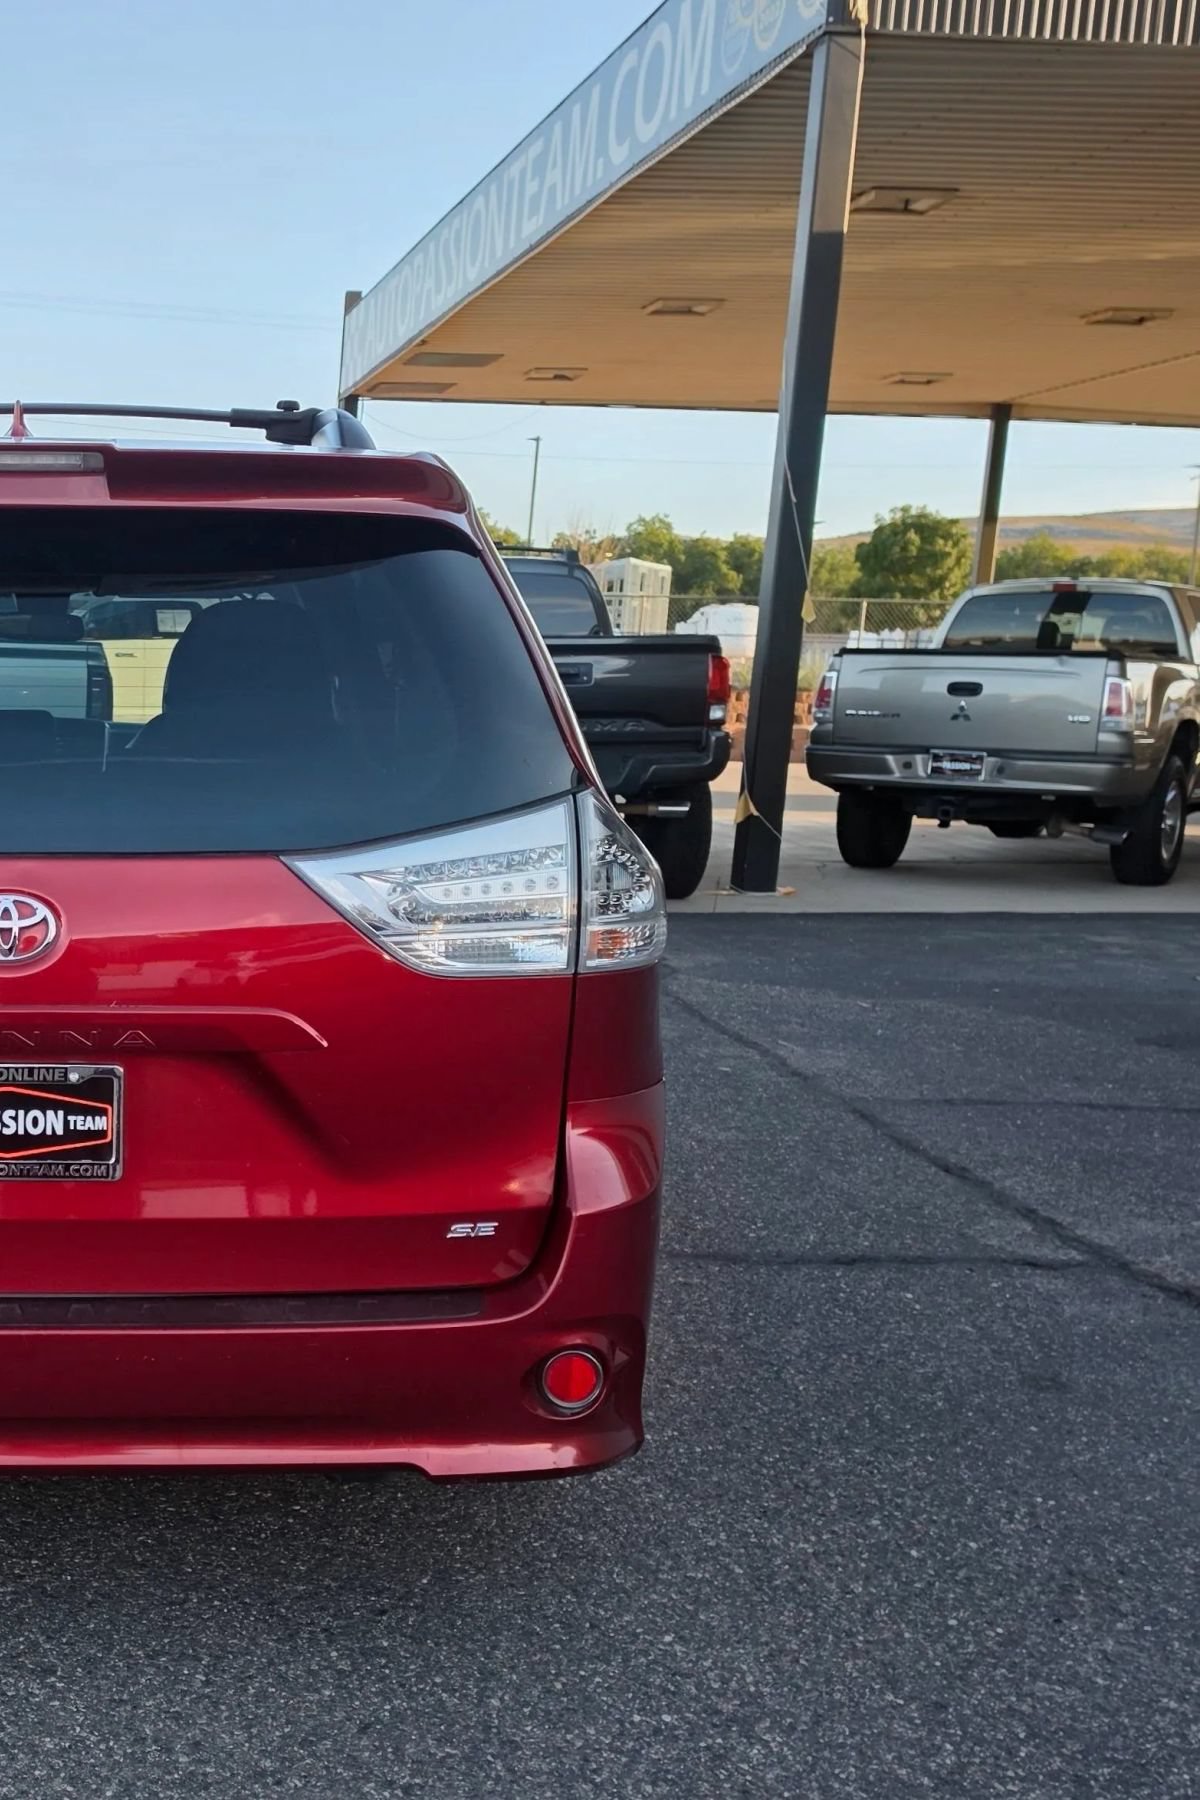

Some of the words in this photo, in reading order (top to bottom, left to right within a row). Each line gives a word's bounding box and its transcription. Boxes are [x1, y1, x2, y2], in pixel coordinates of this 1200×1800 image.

[363, 0, 717, 363] AUTOPASSIONTEAM.COM
[67, 1116, 107, 1130] TEAM
[446, 1222, 499, 1239] SE
